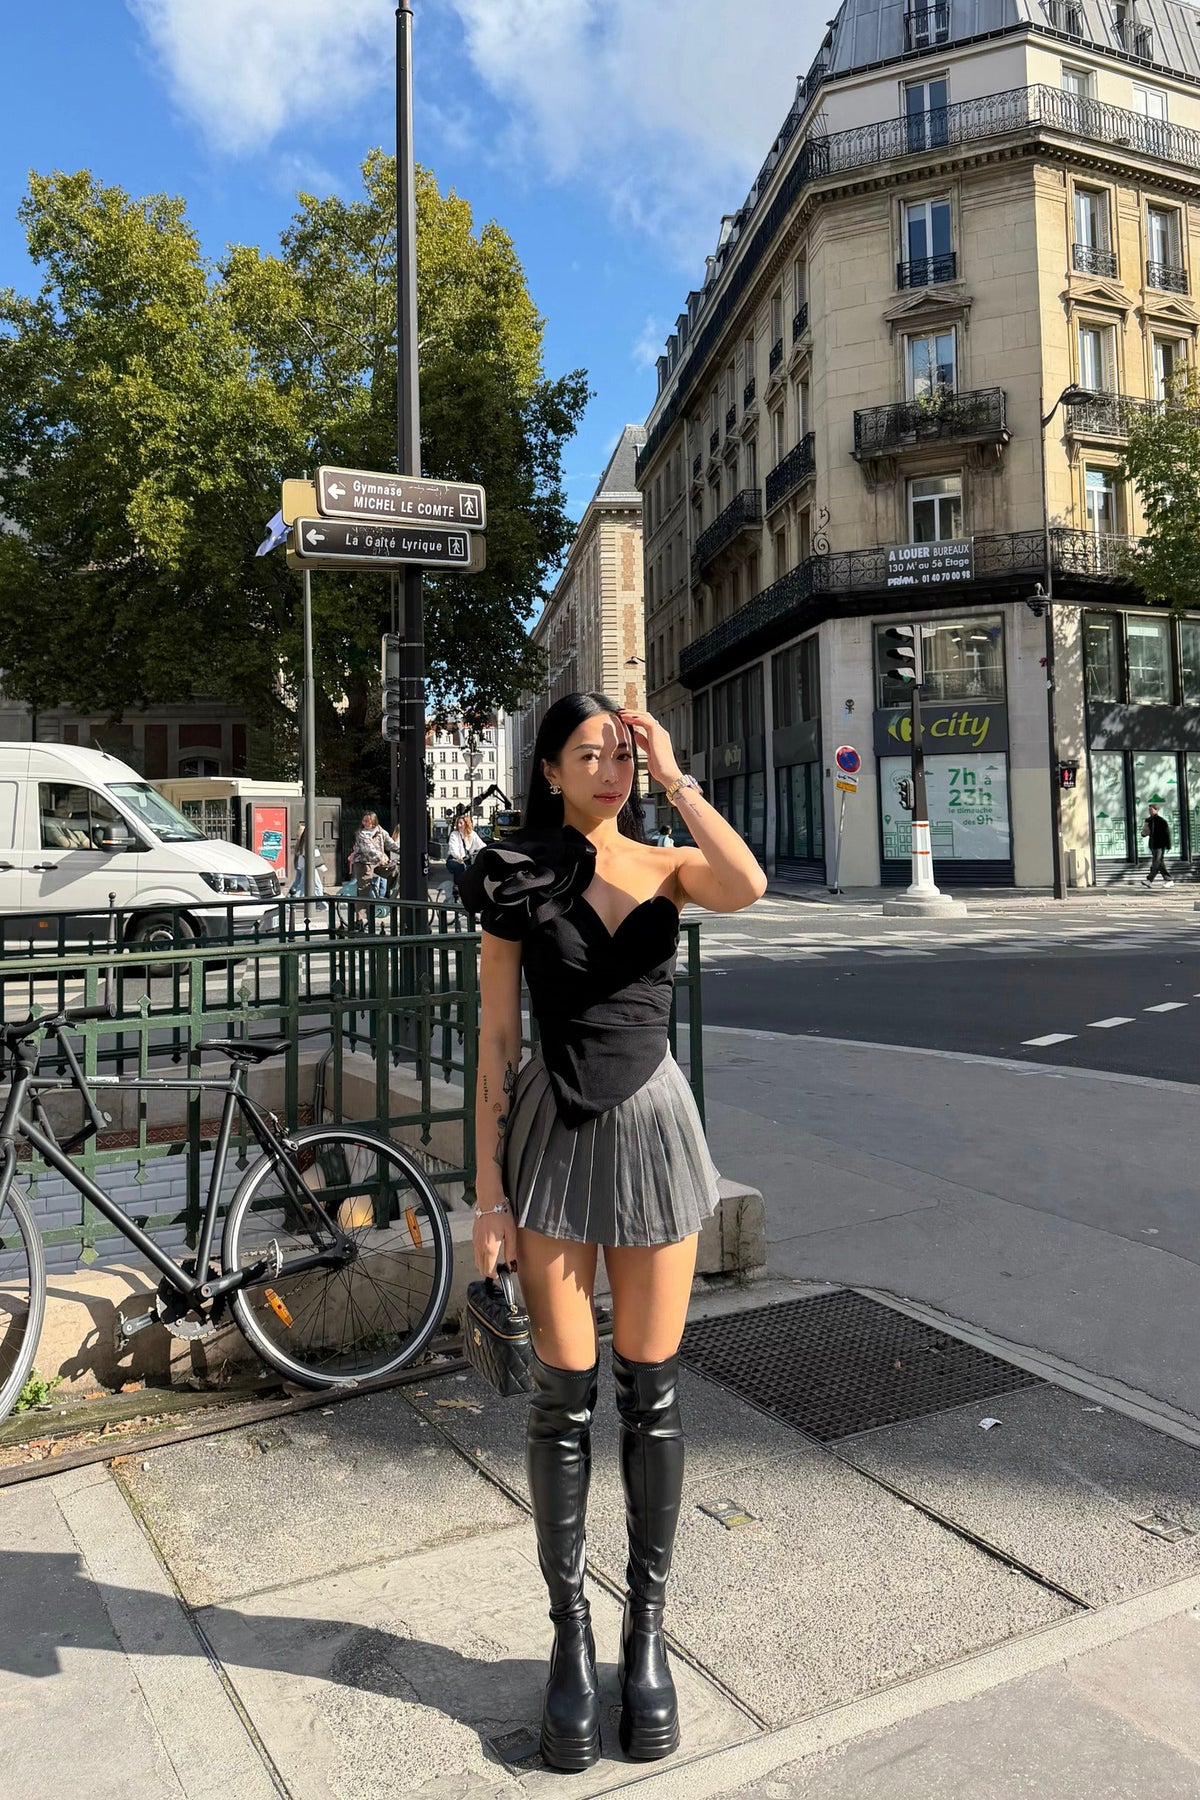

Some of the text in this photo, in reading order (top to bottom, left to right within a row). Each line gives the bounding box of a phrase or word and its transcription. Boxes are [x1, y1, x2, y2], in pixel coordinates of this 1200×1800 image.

[353, 480, 402, 496] Gymnase
[353, 496, 455, 517] MICHEL LE COMTE
[345, 533, 443, 553] La Gaîté Lyrique
[889, 544, 969, 561] A LOUER BUREAUX
[889, 563, 904, 573] 130
[922, 575, 930, 583] 01
[931, 573, 940, 582] 40
[941, 572, 950, 581] 70
[930, 711, 990, 747] city
[948, 767, 976, 786] 7h
[948, 788, 992, 806] 23h
[976, 814, 993, 825] 9h
